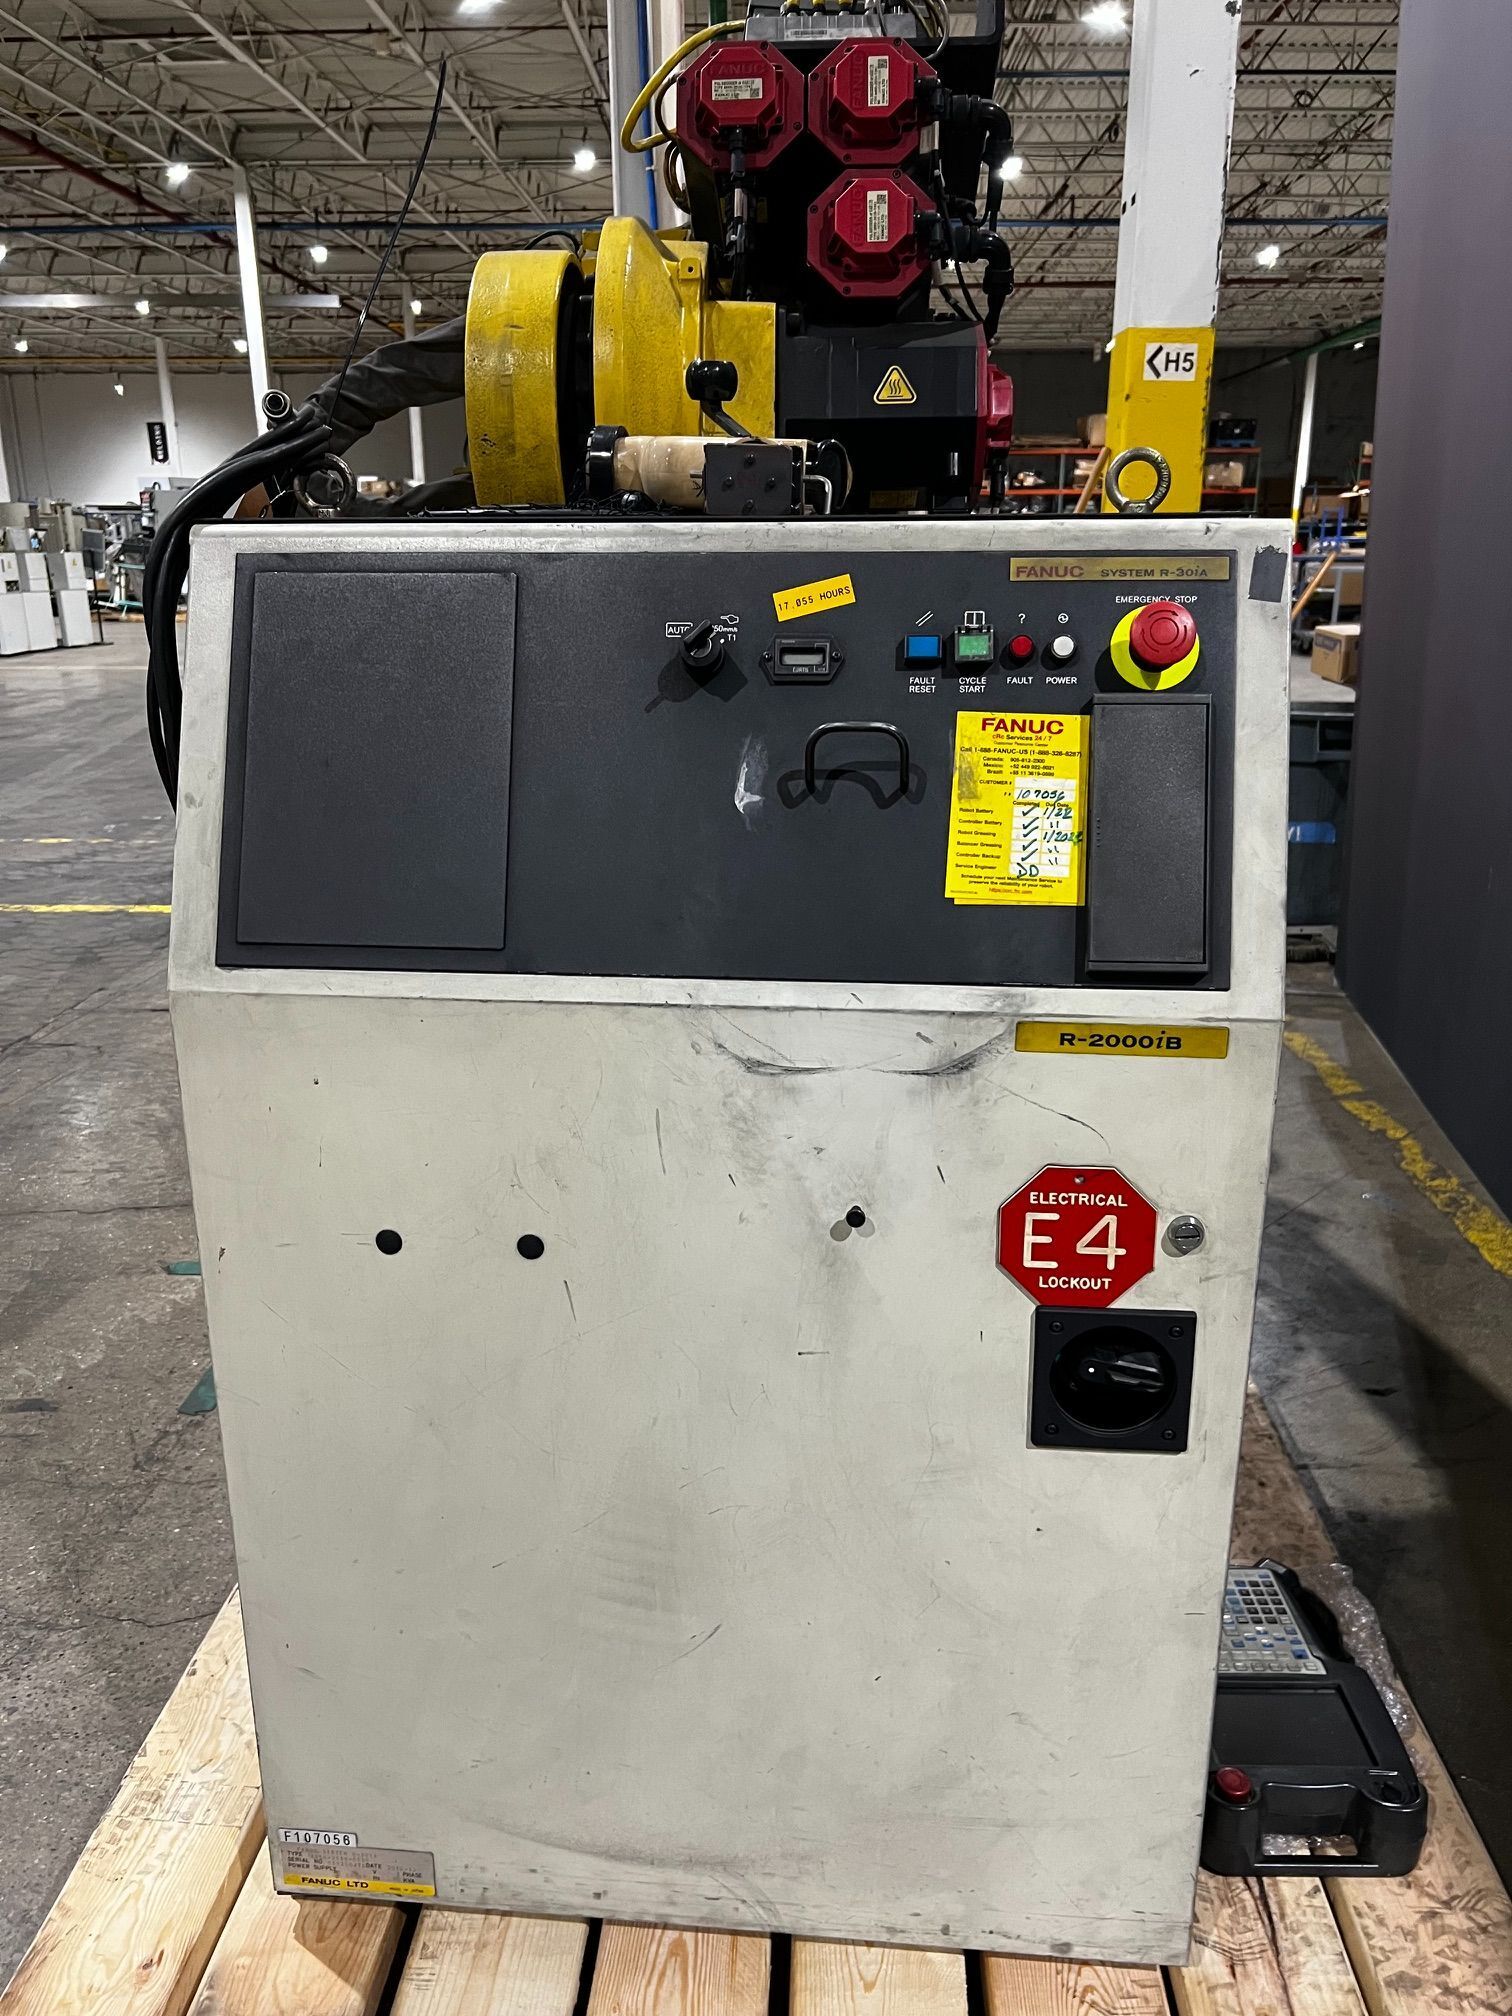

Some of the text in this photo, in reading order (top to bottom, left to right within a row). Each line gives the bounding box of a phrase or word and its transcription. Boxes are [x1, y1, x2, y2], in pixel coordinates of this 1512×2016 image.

[1164, 351, 1195, 373] H5
[1015, 564, 1208, 579] FANUC SYSTEM R-30iA
[819, 586, 851, 601] HOURS
[1115, 595, 1198, 604] EMERGENCY STOP
[727, 633, 737, 642] T1
[909, 676, 936, 685] FAULT
[958, 676, 987, 685] CYCLE
[1006, 676, 1034, 684] FAULT
[1045, 676, 1078, 684] POWER
[909, 685, 936, 693] RESET
[958, 685, 986, 693] START
[981, 717, 1064, 735] FANUC
[974, 747, 1028, 755] 1-888-FANUC-US
[1059, 1030, 1182, 1050] R-2000iB
[1029, 1191, 1128, 1207] ELECTRICAL
[1022, 1212, 1127, 1271] E 4
[1038, 1275, 1112, 1290] LOCKOUT
[284, 1830, 351, 1846] F107056
[301, 1876, 369, 1888] FANUC LTD
